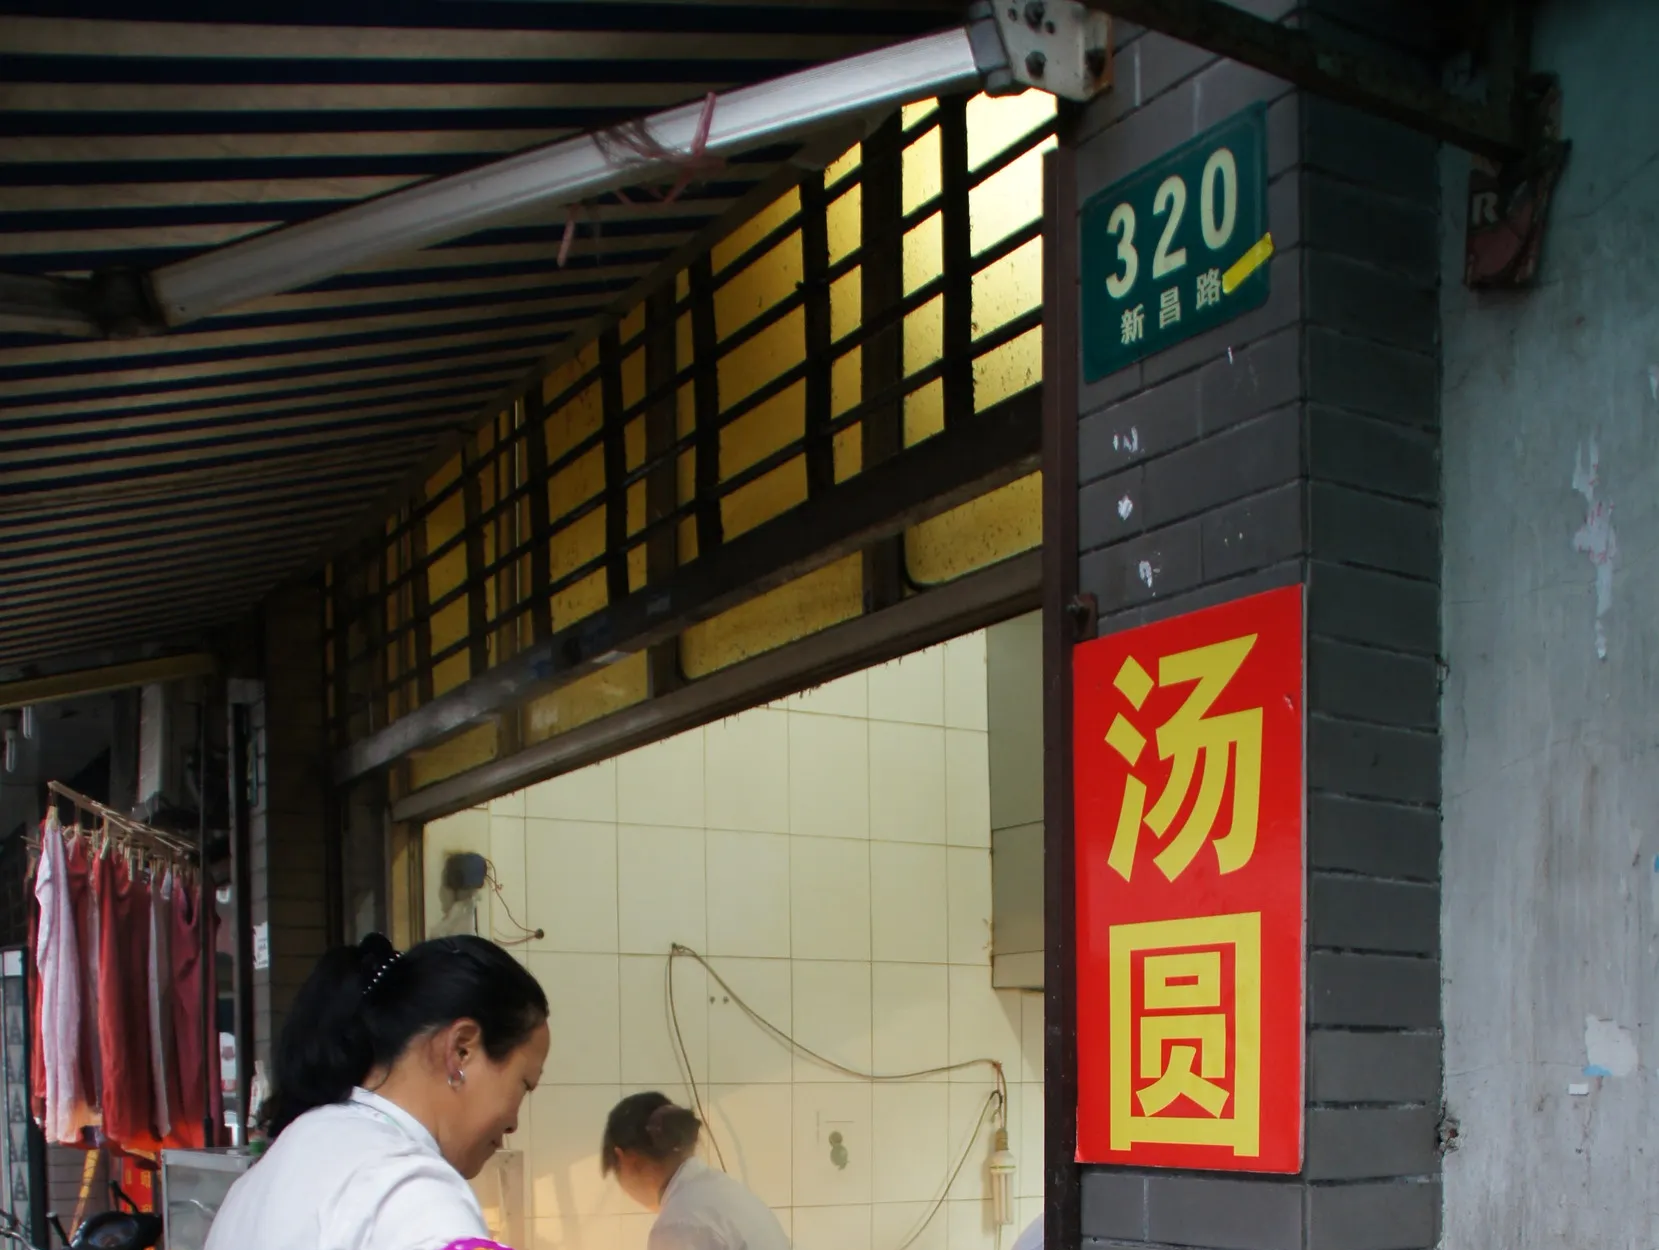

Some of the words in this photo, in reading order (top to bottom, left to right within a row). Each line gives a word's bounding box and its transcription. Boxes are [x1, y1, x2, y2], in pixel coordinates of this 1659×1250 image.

[1105, 147, 1237, 299] 320
[1120, 268, 1221, 345] 新昌路
[1104, 633, 1263, 1157] 汤圆
